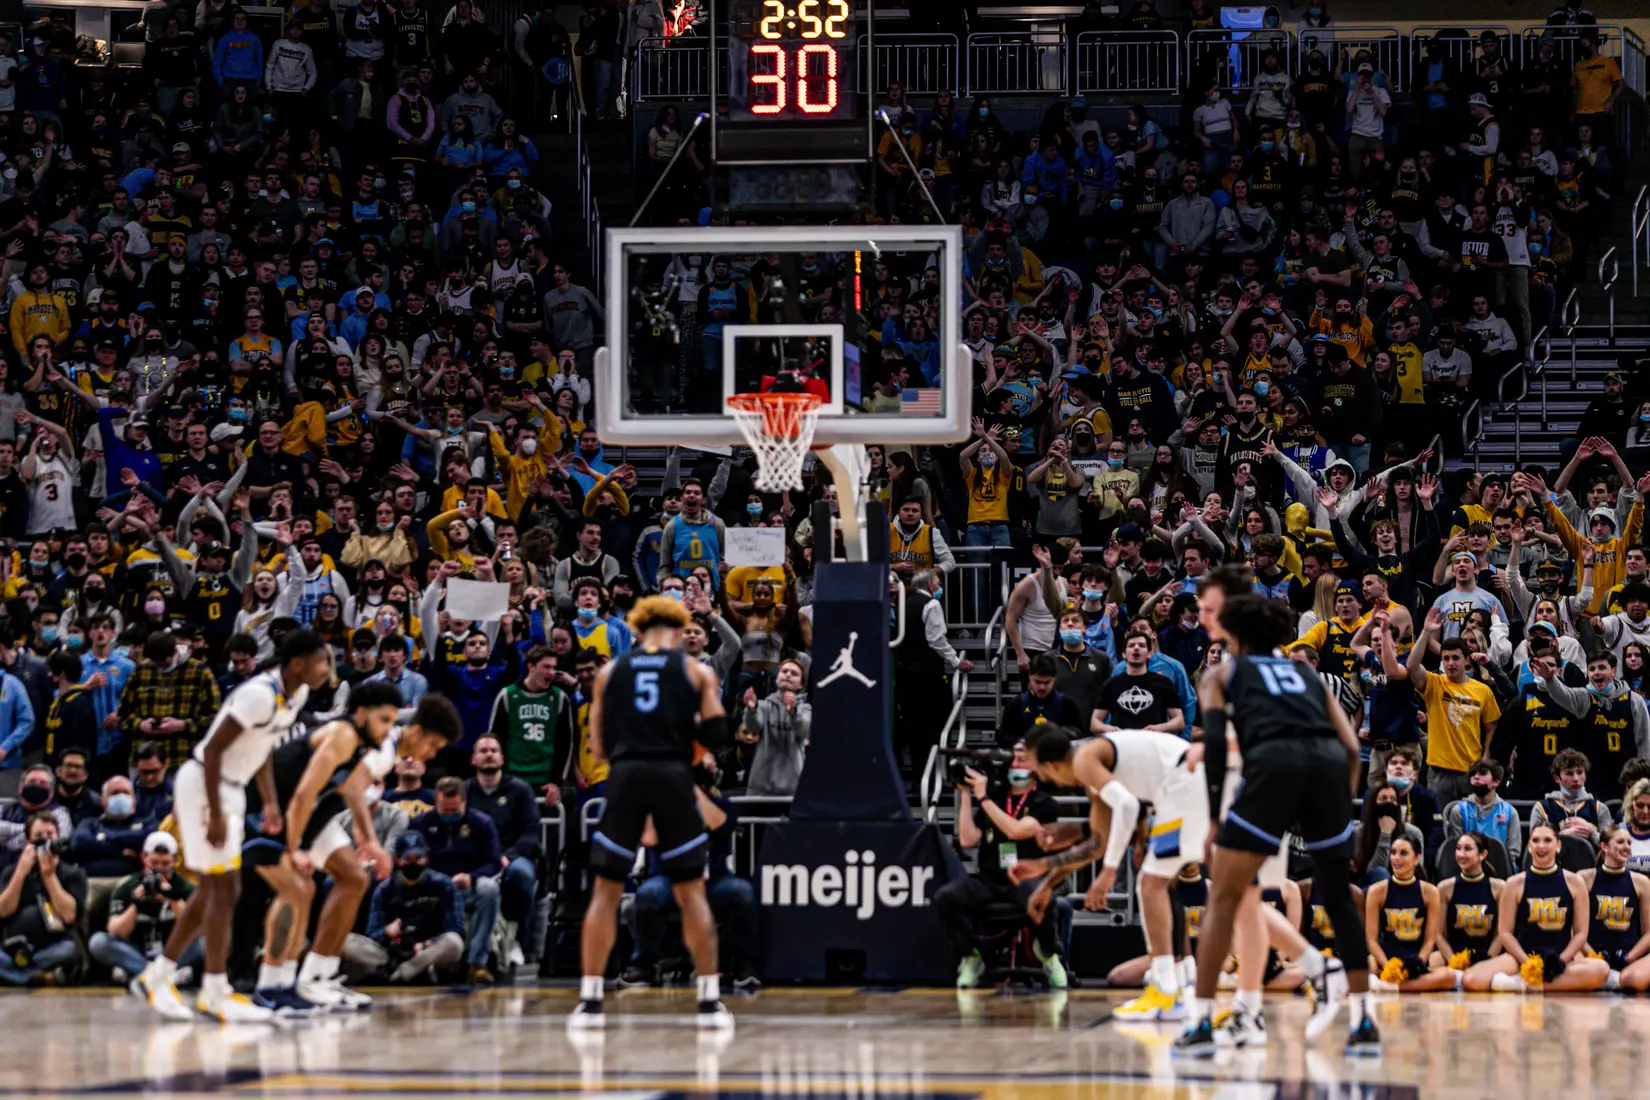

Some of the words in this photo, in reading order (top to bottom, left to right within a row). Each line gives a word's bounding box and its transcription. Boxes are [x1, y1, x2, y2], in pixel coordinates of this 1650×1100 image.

[760, 0, 849, 40] 2:52
[408, 34, 417, 46] 3
[750, 44, 838, 115] 30
[1489, 81, 1499, 93] 3
[1265, 166, 1272, 181] 3
[1496, 223, 1516, 238] 33
[1463, 241, 1490, 257] BETTER
[1398, 361, 1407, 377] 3
[45, 485, 58, 502] 3
[689, 540, 704, 560] 0
[208, 601, 222, 621] 0
[1453, 602, 1473, 616] M
[1257, 662, 1306, 697] 15
[632, 670, 660, 714] 5
[518, 703, 550, 721] CELTICS
[1531, 716, 1569, 728] Marquette
[522, 722, 545, 742] 36
[1607, 731, 1621, 752] 0
[1543, 732, 1557, 756] 0
[760, 849, 934, 920] meijer
[1454, 903, 1494, 938] MU
[1527, 896, 1567, 931] MU
[1596, 895, 1634, 932] MU
[1384, 906, 1425, 942] MU
